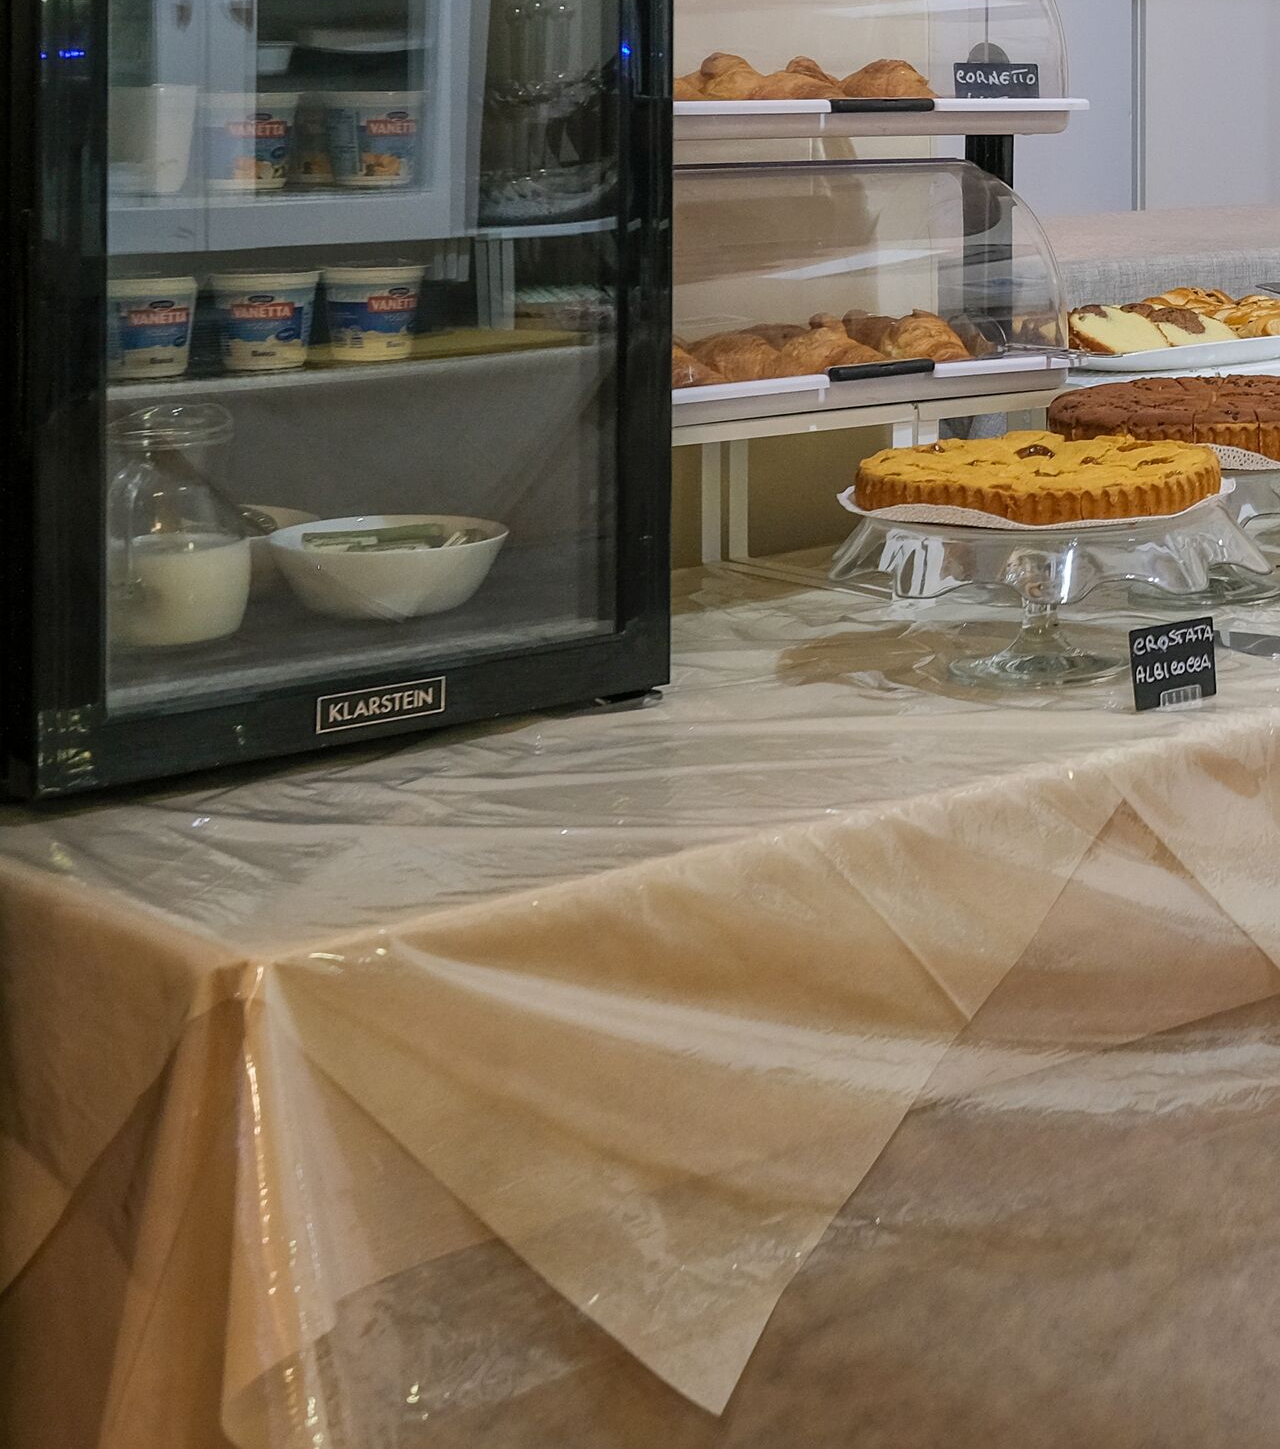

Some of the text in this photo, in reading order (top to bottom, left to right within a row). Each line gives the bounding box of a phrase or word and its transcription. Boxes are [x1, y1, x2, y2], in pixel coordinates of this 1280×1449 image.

[956, 68, 1036, 85] CORNETTO
[1133, 625, 1214, 656] CROSTATA
[1136, 653, 1212, 684] ALBICOCCA
[328, 687, 434, 723] KLARSTEIN
